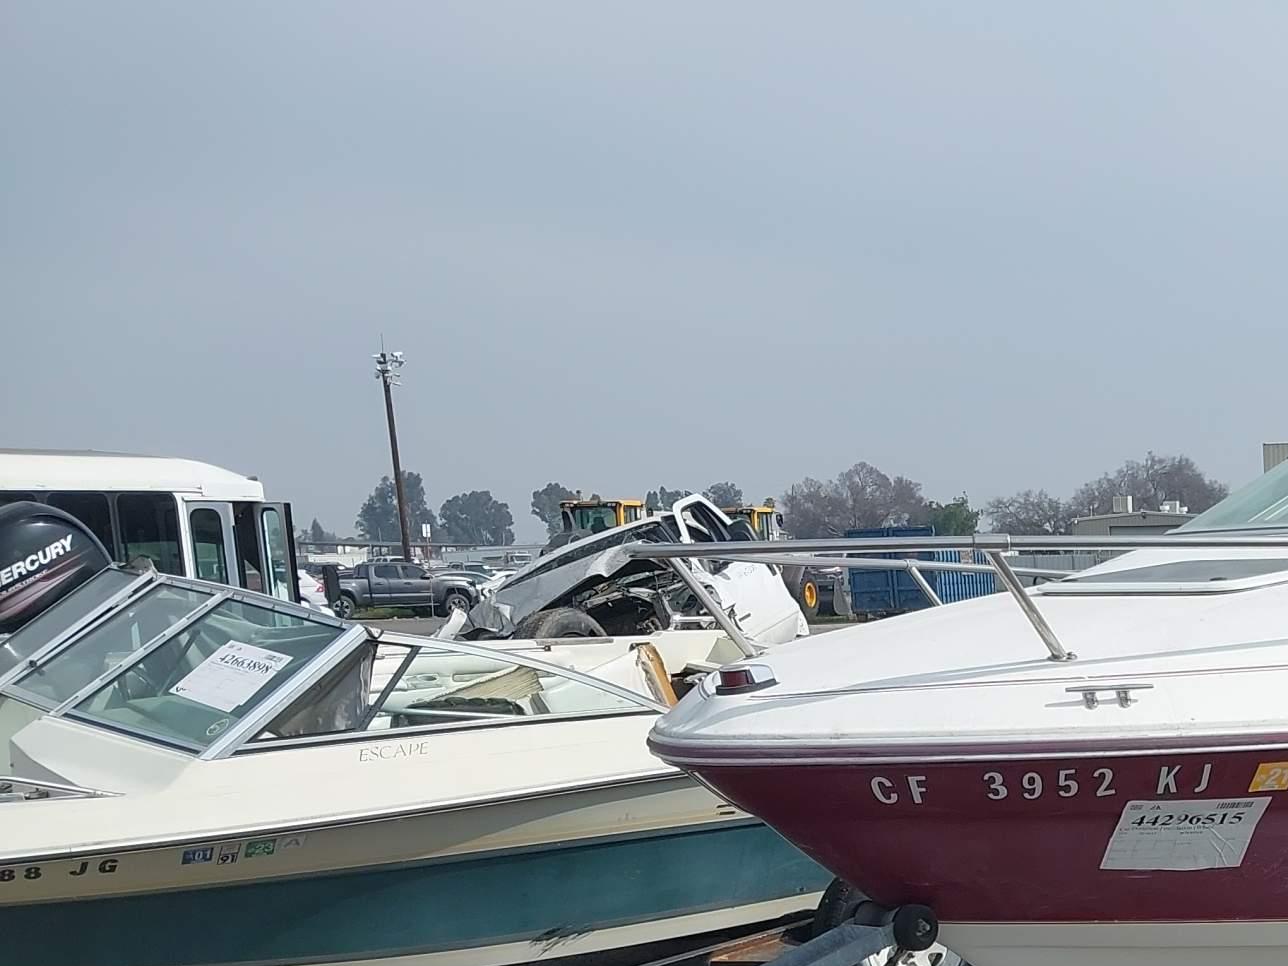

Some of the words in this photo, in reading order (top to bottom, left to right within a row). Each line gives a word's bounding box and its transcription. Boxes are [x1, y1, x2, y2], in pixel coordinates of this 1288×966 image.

[0, 534, 73, 587] ERCURY
[218, 653, 273, 674] 42663898
[359, 742, 429, 762] ESCAPE
[870, 775, 927, 804] CF
[982, 769, 1116, 799] 3952
[1156, 763, 1212, 795] KJ
[1131, 811, 1246, 828] 44296515
[69, 859, 119, 876] JG
